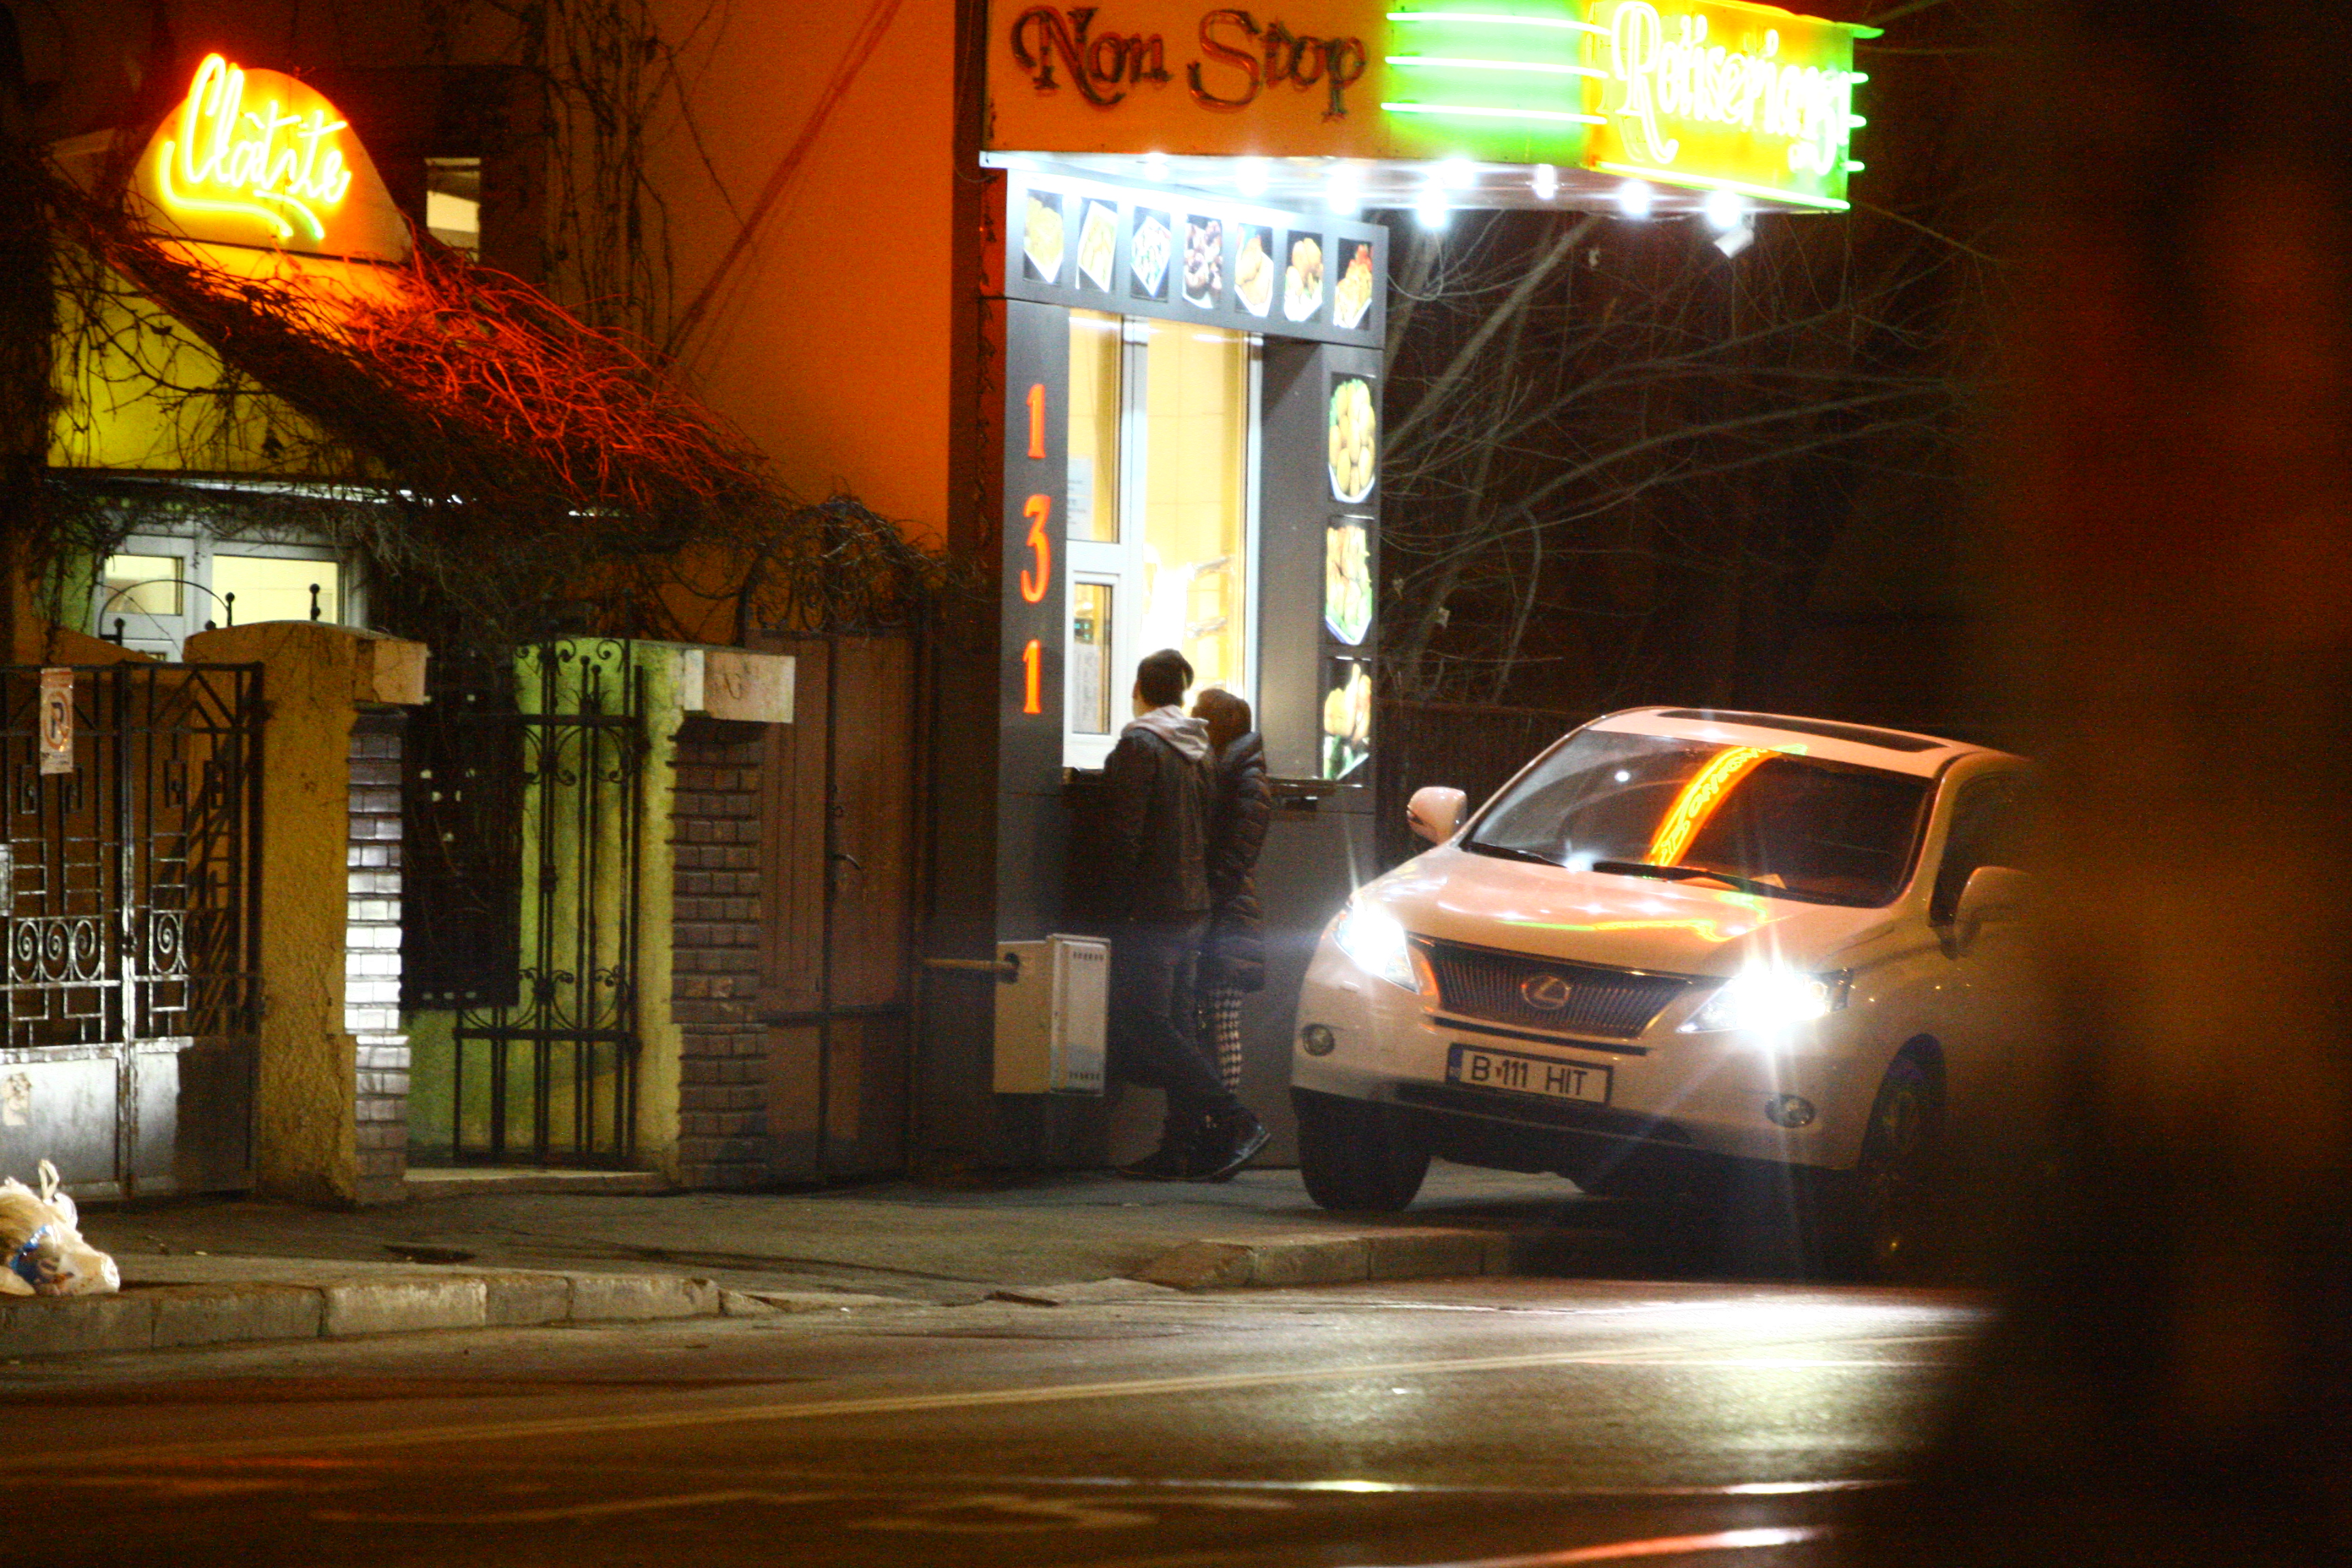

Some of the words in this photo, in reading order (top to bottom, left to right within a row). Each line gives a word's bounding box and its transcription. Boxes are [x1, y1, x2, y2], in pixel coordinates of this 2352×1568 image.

[1010, 5, 1173, 111] Non
[1186, 9, 1367, 122] Stop
[1471, 1055, 1490, 1081] B
[1501, 1059, 1529, 1088] 111
[1545, 1066, 1587, 1096] HIT
